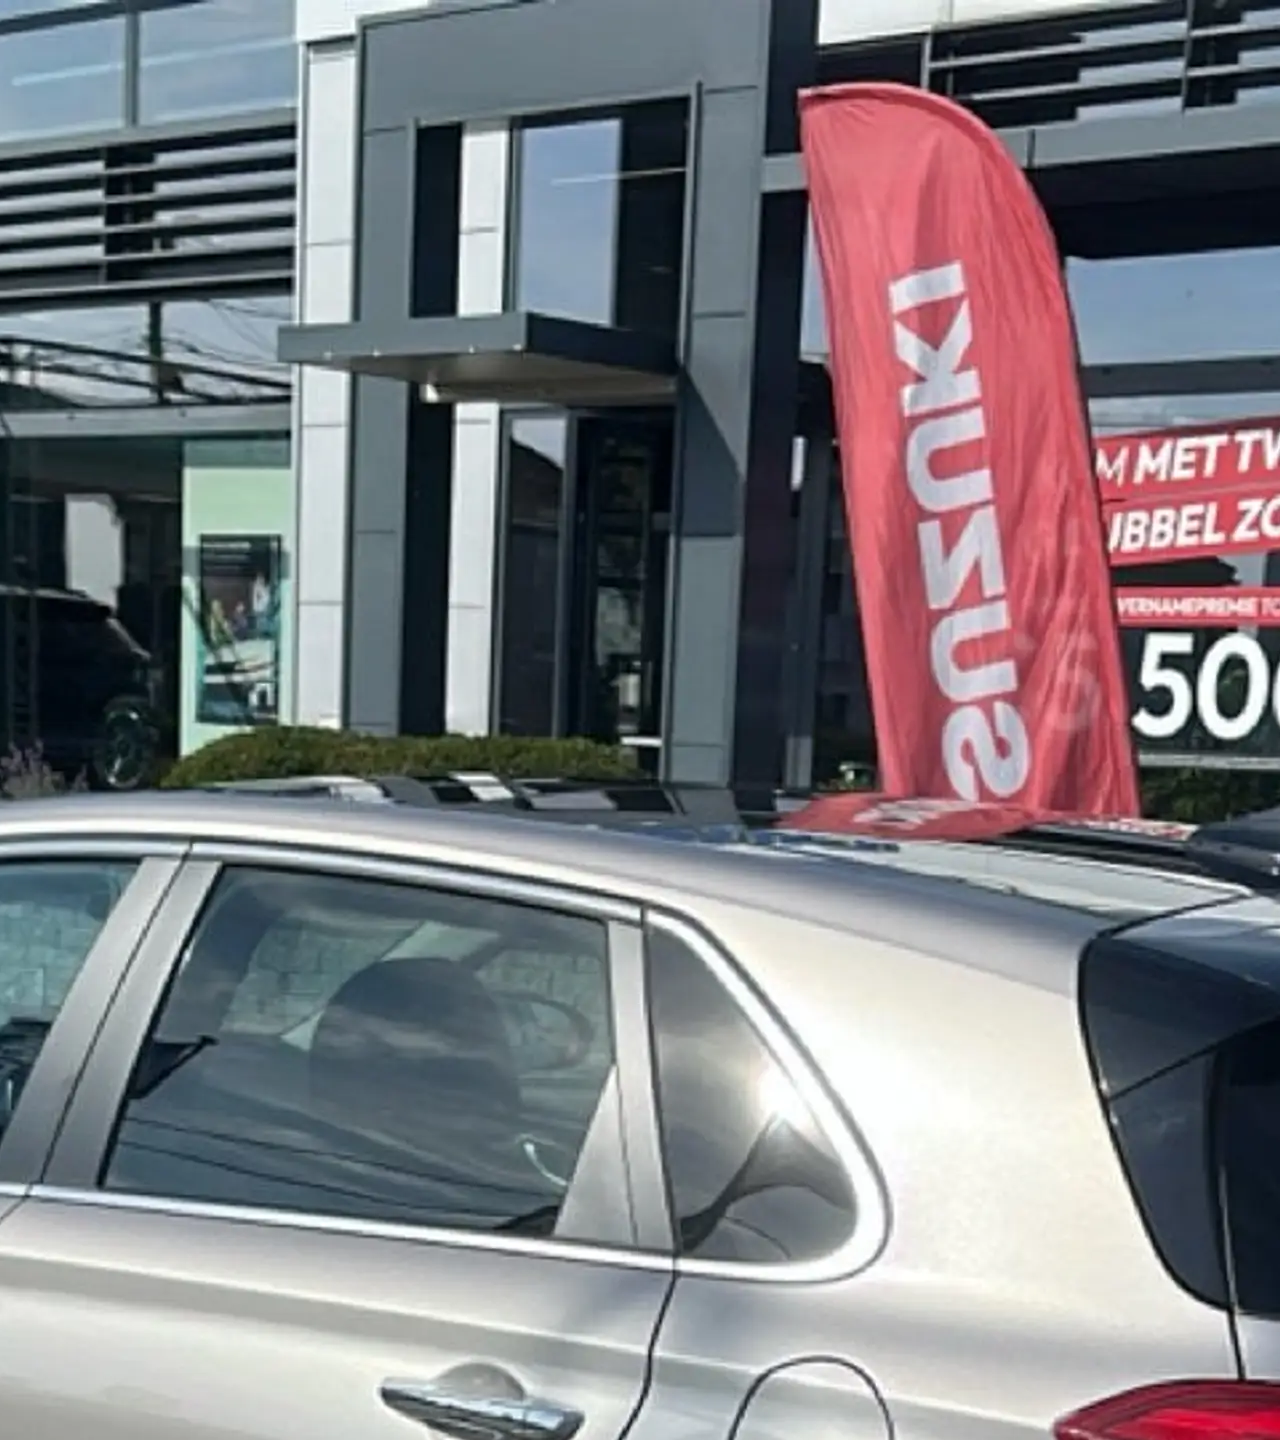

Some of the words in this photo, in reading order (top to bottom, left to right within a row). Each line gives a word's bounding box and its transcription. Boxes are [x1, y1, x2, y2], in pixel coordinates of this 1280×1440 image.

[1096, 446, 1129, 487] M
[1132, 434, 1227, 484] MET
[1116, 596, 1258, 617] VERNAMEPREMIE
